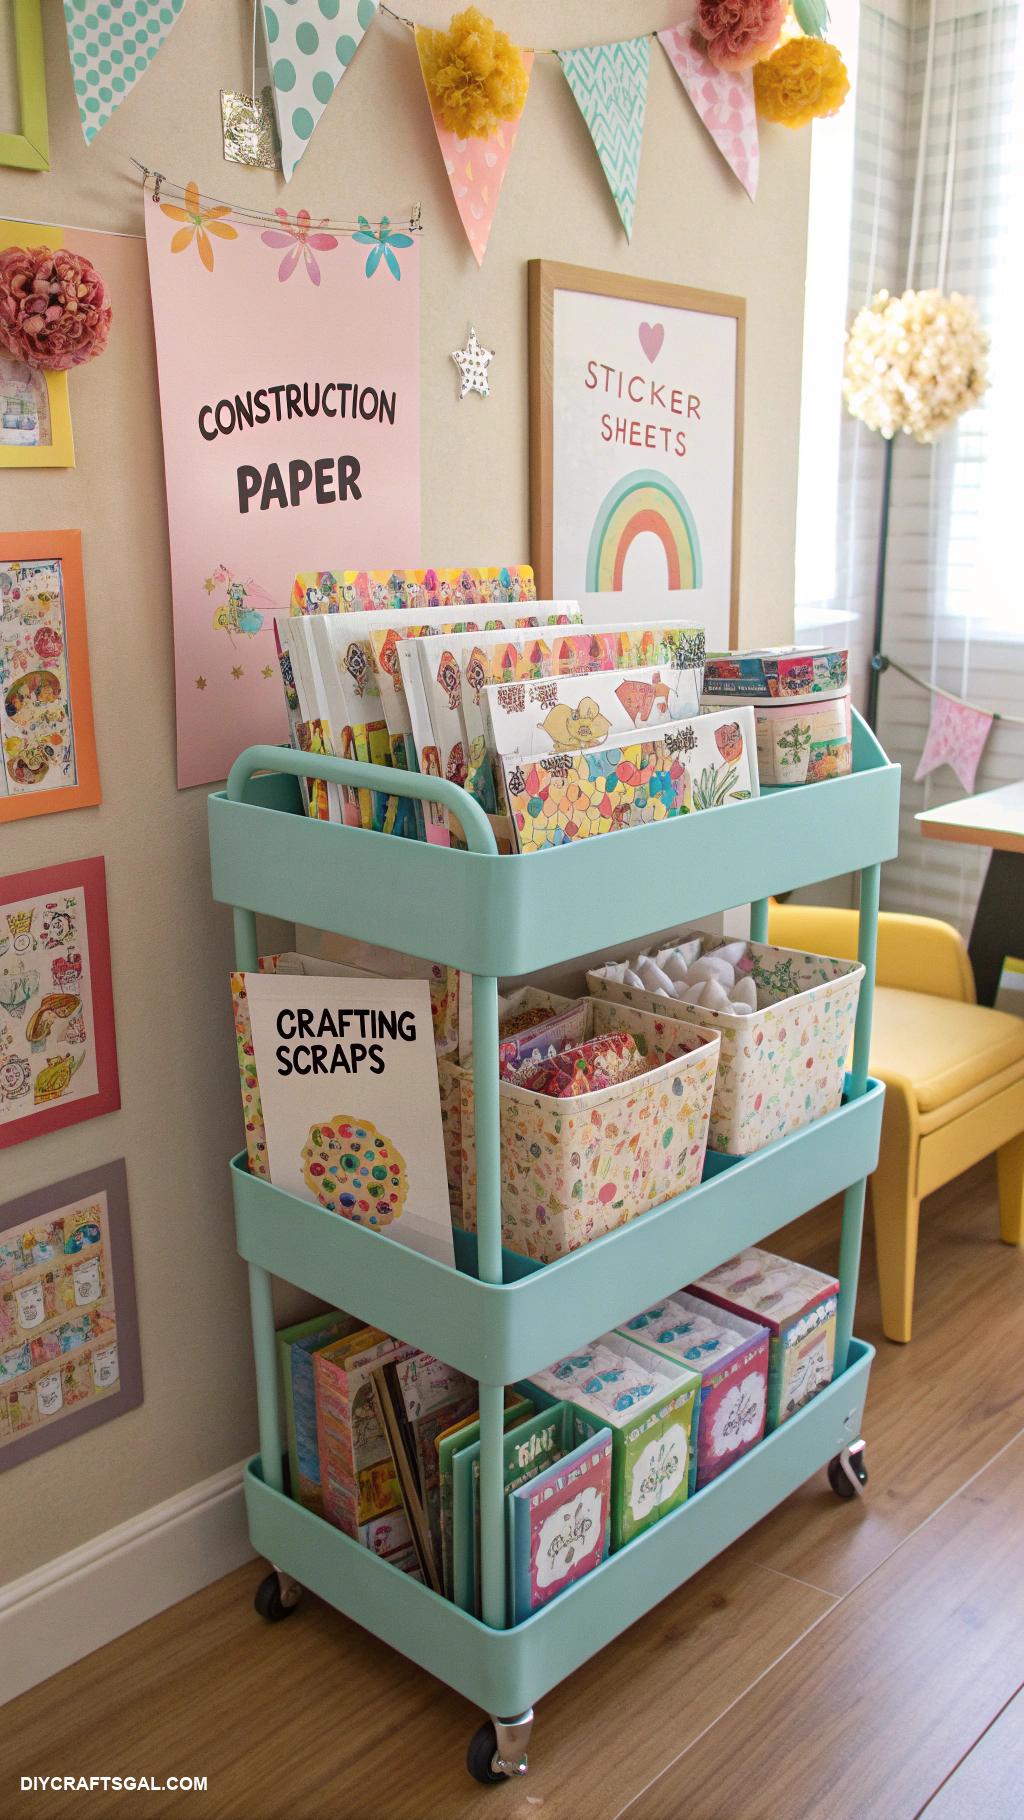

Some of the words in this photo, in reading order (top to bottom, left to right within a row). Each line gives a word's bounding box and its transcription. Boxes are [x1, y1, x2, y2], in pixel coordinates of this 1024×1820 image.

[198, 382, 396, 441] CONSTRUCTION
[584, 361, 701, 420] STICKER
[600, 414, 687, 457] SHEETS
[237, 455, 362, 513] PAPER
[276, 1008, 417, 1042] CRAFTING
[276, 1044, 385, 1076] SCRAPS
